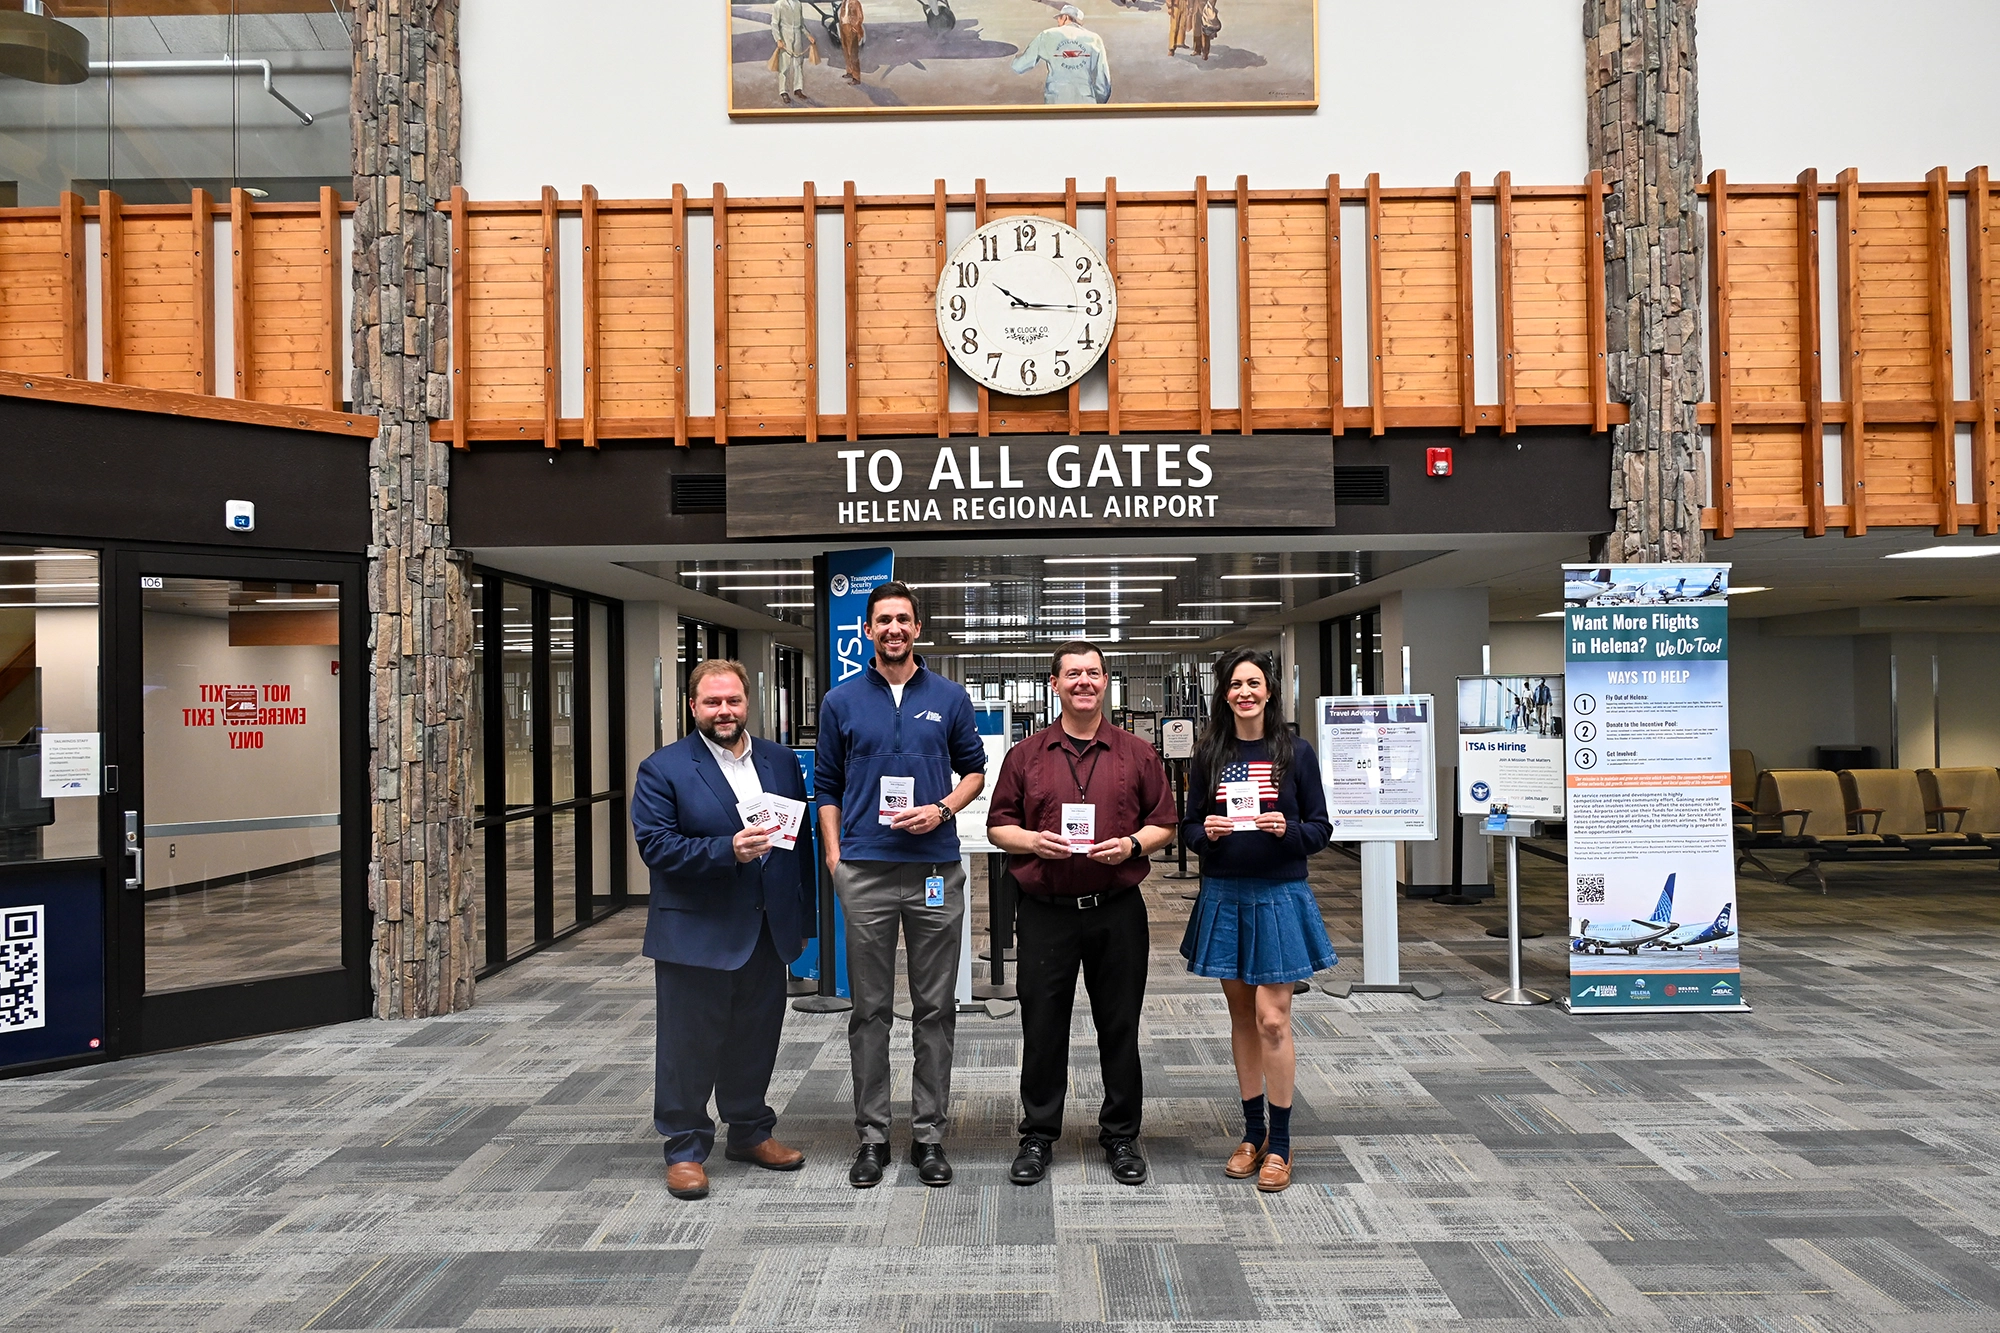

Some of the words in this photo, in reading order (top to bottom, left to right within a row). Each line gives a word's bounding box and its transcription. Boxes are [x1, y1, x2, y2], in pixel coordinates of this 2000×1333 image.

[1061, 60, 1086, 70] EXPRESS
[980, 234, 1001, 262] 11
[1014, 225, 1036, 252] 12
[1052, 232, 1064, 258] 1
[956, 262, 979, 288] 10
[1076, 257, 1092, 283] 2
[950, 294, 966, 321] 9
[1085, 289, 1102, 316] 3
[961, 328, 979, 354] 8
[1077, 323, 1094, 350] 4
[986, 353, 1002, 378] 7
[1020, 359, 1037, 386] 6
[1054, 350, 1070, 377] 5
[837, 449, 903, 493] TO
[928, 446, 1024, 490] ALL
[1047, 444, 1213, 489] GATES
[838, 499, 942, 524] HELENA
[952, 496, 1093, 521] REGIONAL
[1103, 495, 1219, 518] AIRPORT
[144, 578, 160, 587] 106
[850, 574, 888, 582] Transportation
[1572, 615, 1608, 630] Want
[1613, 614, 1647, 630] More
[1652, 613, 1699, 632] Flights
[837, 616, 862, 682] TSA
[1572, 639, 1586, 654] in
[1591, 637, 1647, 653] Helena?
[1656, 640, 1676, 657] We
[1677, 638, 1695, 655] Do
[1694, 637, 1722, 653] Too!
[1608, 671, 1638, 685] WAYS
[1642, 671, 1656, 684] TO
[1661, 670, 1690, 684] HELP
[1582, 699, 1587, 710] 1
[1582, 726, 1589, 737] 2
[1468, 742, 1486, 751] TSA
[1488, 742, 1496, 751] is
[1498, 742, 1526, 753] Hiring
[1583, 753, 1589, 764] 3
